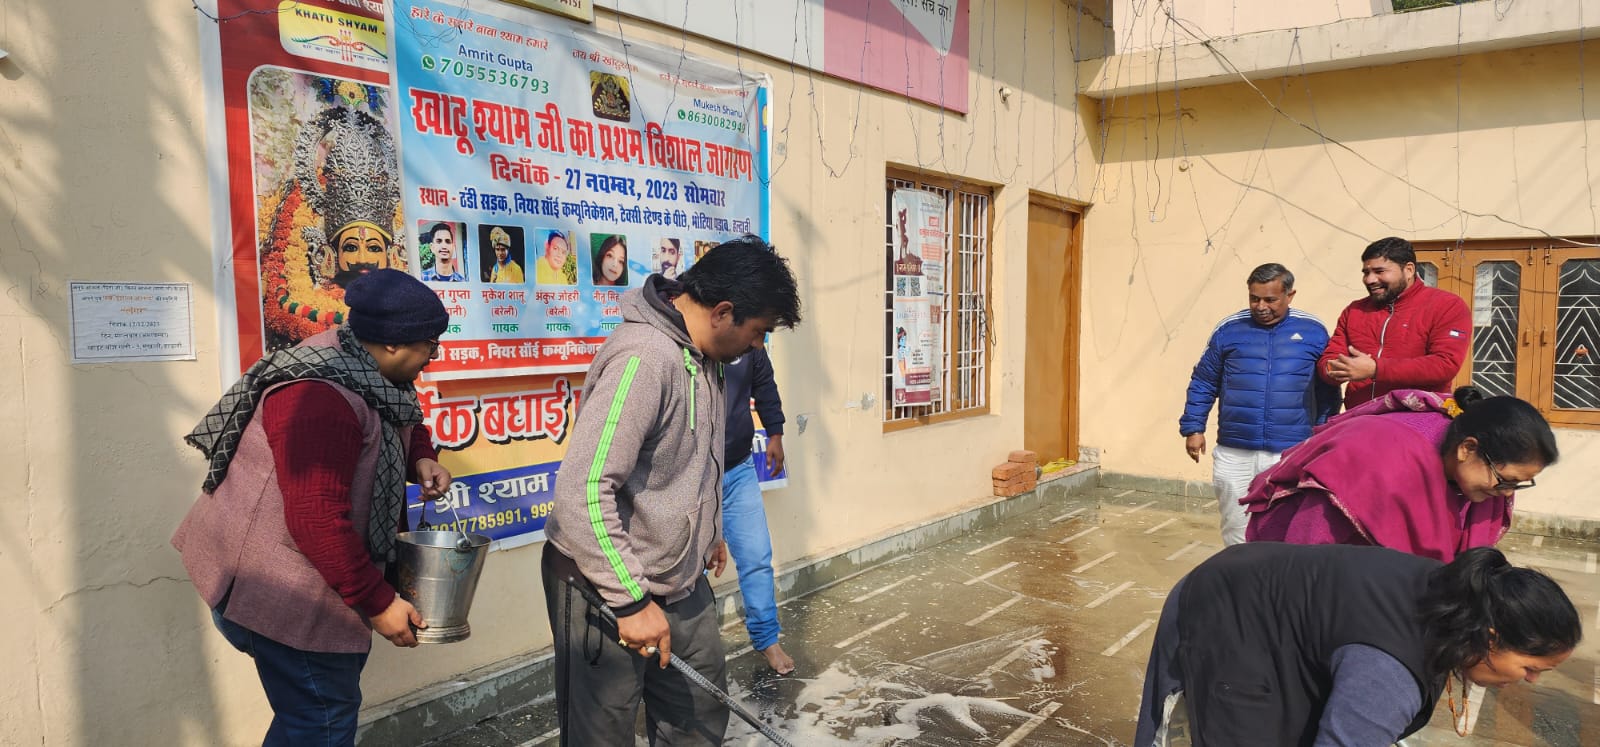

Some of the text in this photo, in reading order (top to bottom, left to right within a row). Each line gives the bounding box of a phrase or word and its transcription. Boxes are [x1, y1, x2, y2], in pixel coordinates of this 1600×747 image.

[295, 8, 378, 34] KHATU SHYAM
[500, 31, 523, 45] श्याम
[526, 38, 548, 51] हमारे
[458, 44, 533, 73] Amrit Gupta
[440, 58, 549, 95] 7055536793
[693, 98, 743, 118] Mukesh Shanu
[410, 88, 753, 182] खाटू श्याम जी का प्रथम विशाल जागरण
[565, 168, 581, 190] 27
[585, 173, 641, 201] नवम्बर,
[645, 178, 678, 201] 2023
[684, 181, 726, 207] सोमवार
[419, 187, 449, 207] स्थान
[459, 187, 478, 209] ठंडी
[514, 193, 539, 215] नियर
[663, 208, 672, 226] के
[447, 289, 472, 304] गुप्ता
[482, 288, 505, 304] मुकेश
[492, 323, 519, 333] गायक
[545, 322, 572, 332] गायक
[448, 347, 484, 365] सड़क,
[487, 343, 517, 359] नियर
[483, 379, 567, 438] बधाई
[478, 472, 550, 504] श्याम
